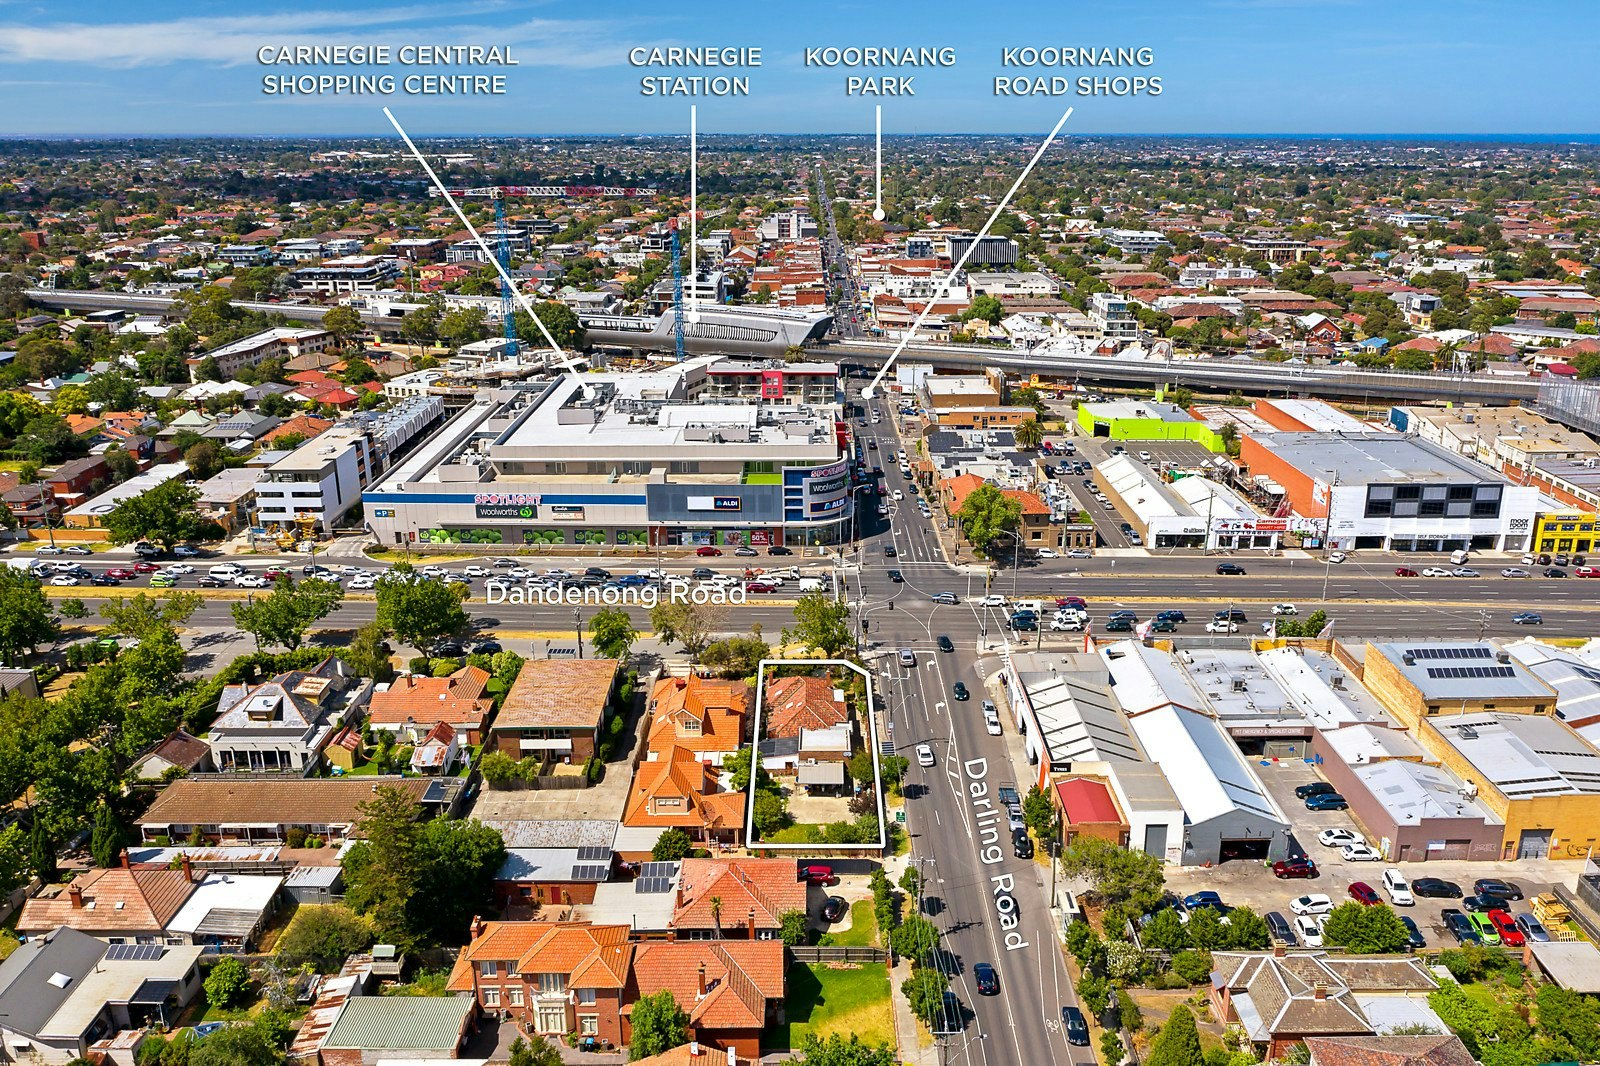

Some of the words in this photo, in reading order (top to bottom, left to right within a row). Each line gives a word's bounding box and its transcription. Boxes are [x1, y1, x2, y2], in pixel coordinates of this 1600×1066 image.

[474, 493, 541, 505] SPOTLIGHT
[832, 499, 845, 508] ALDI
[480, 507, 518, 516] Woolworths
